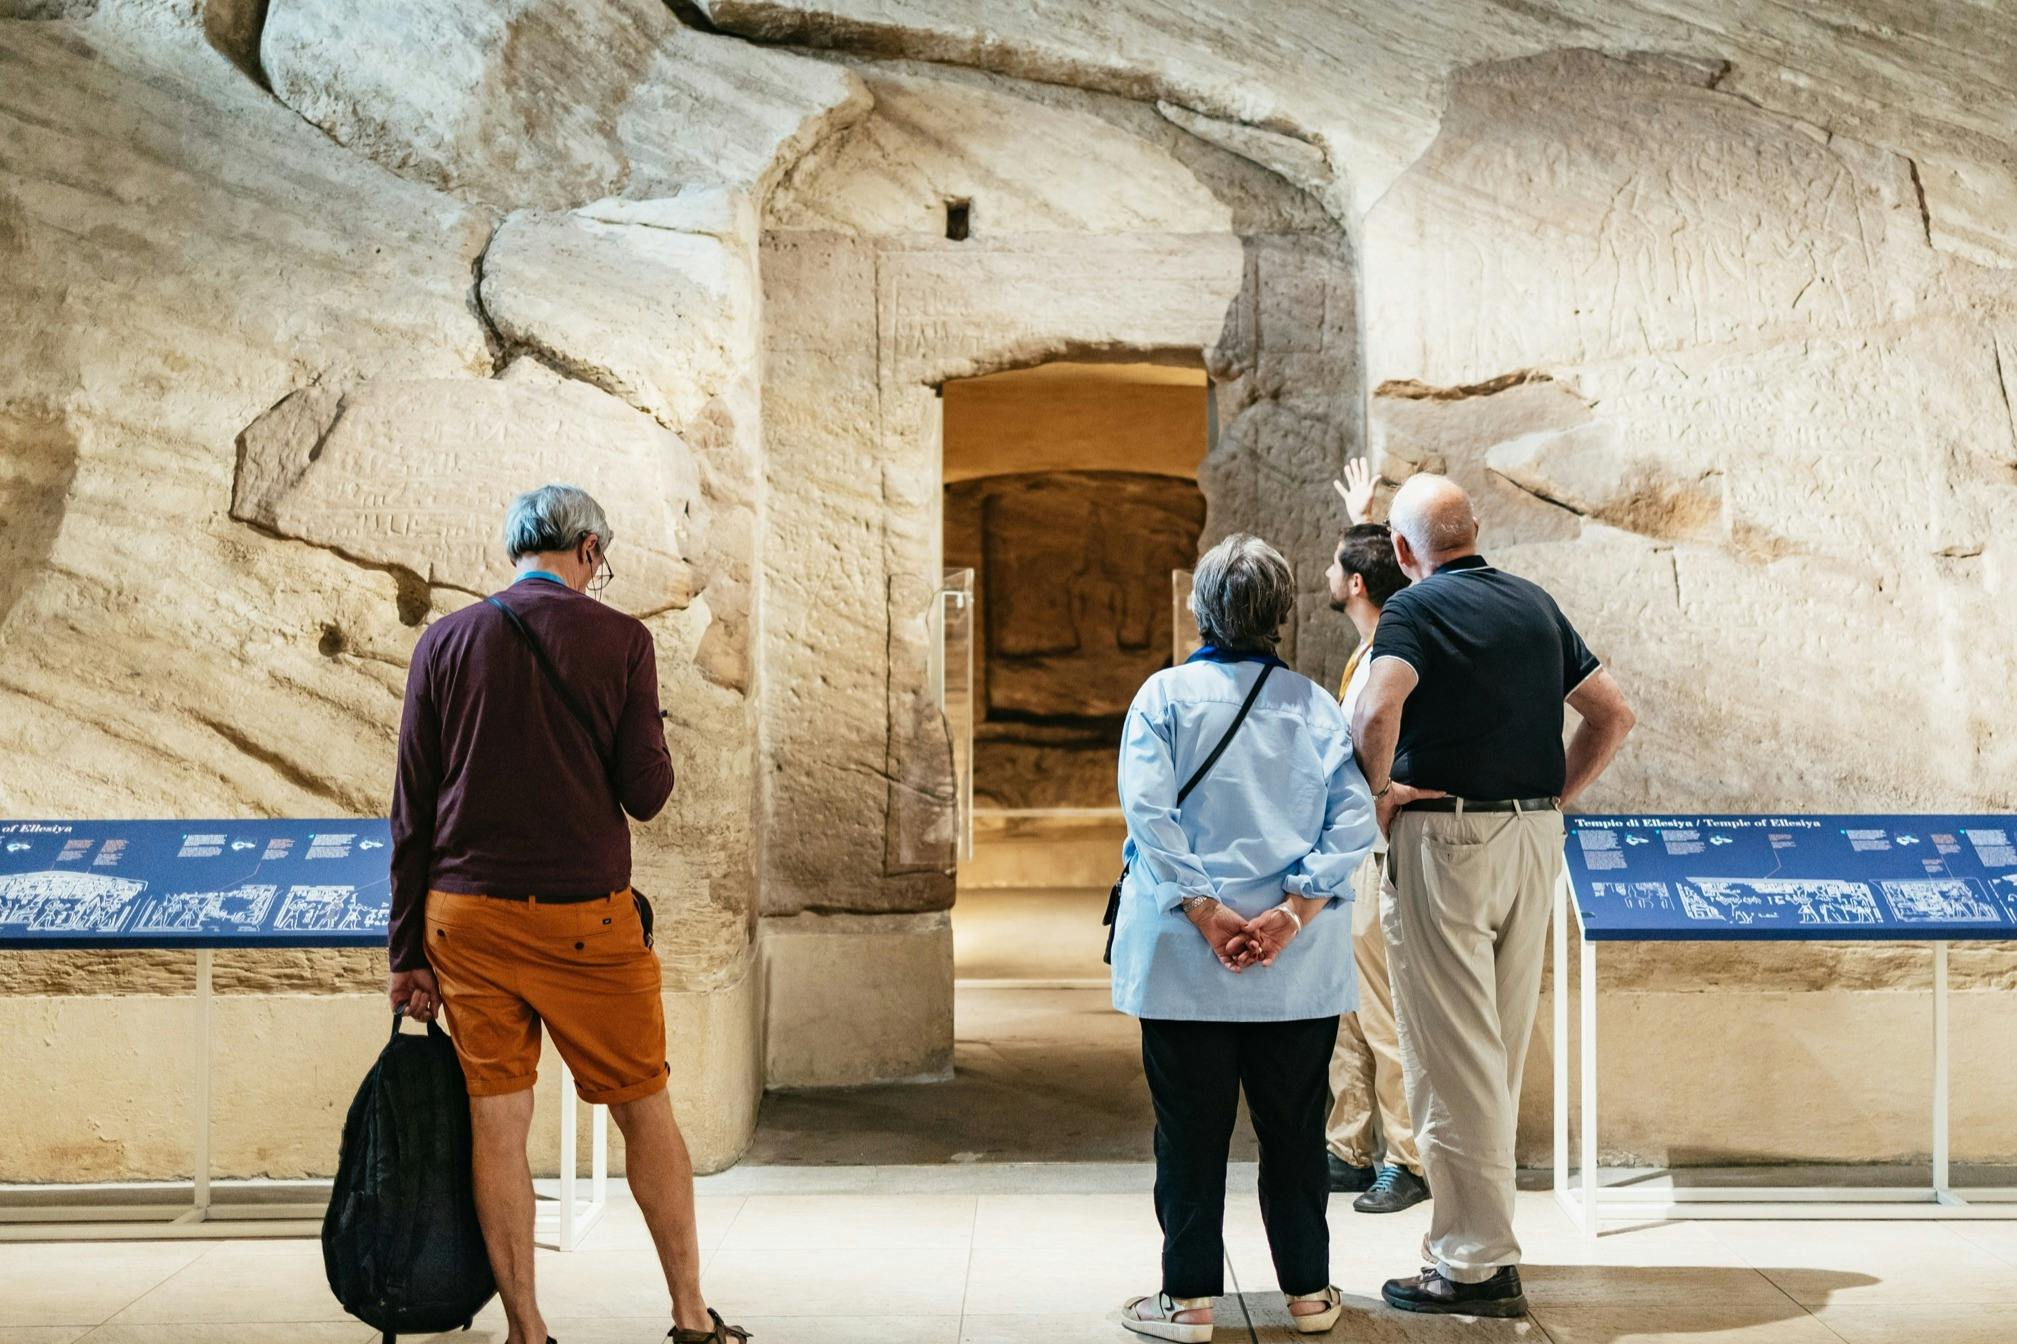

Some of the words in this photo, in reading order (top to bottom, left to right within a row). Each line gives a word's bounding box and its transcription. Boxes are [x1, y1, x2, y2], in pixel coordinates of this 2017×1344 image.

[2, 824, 19, 833] of
[1575, 819, 1623, 829] Tempio
[1626, 819, 1640, 828] di
[1642, 819, 1693, 829] Ellesiya
[1703, 819, 1751, 829] Temple
[1754, 819, 1767, 828] of
[1770, 819, 1820, 829] Ellesiya
